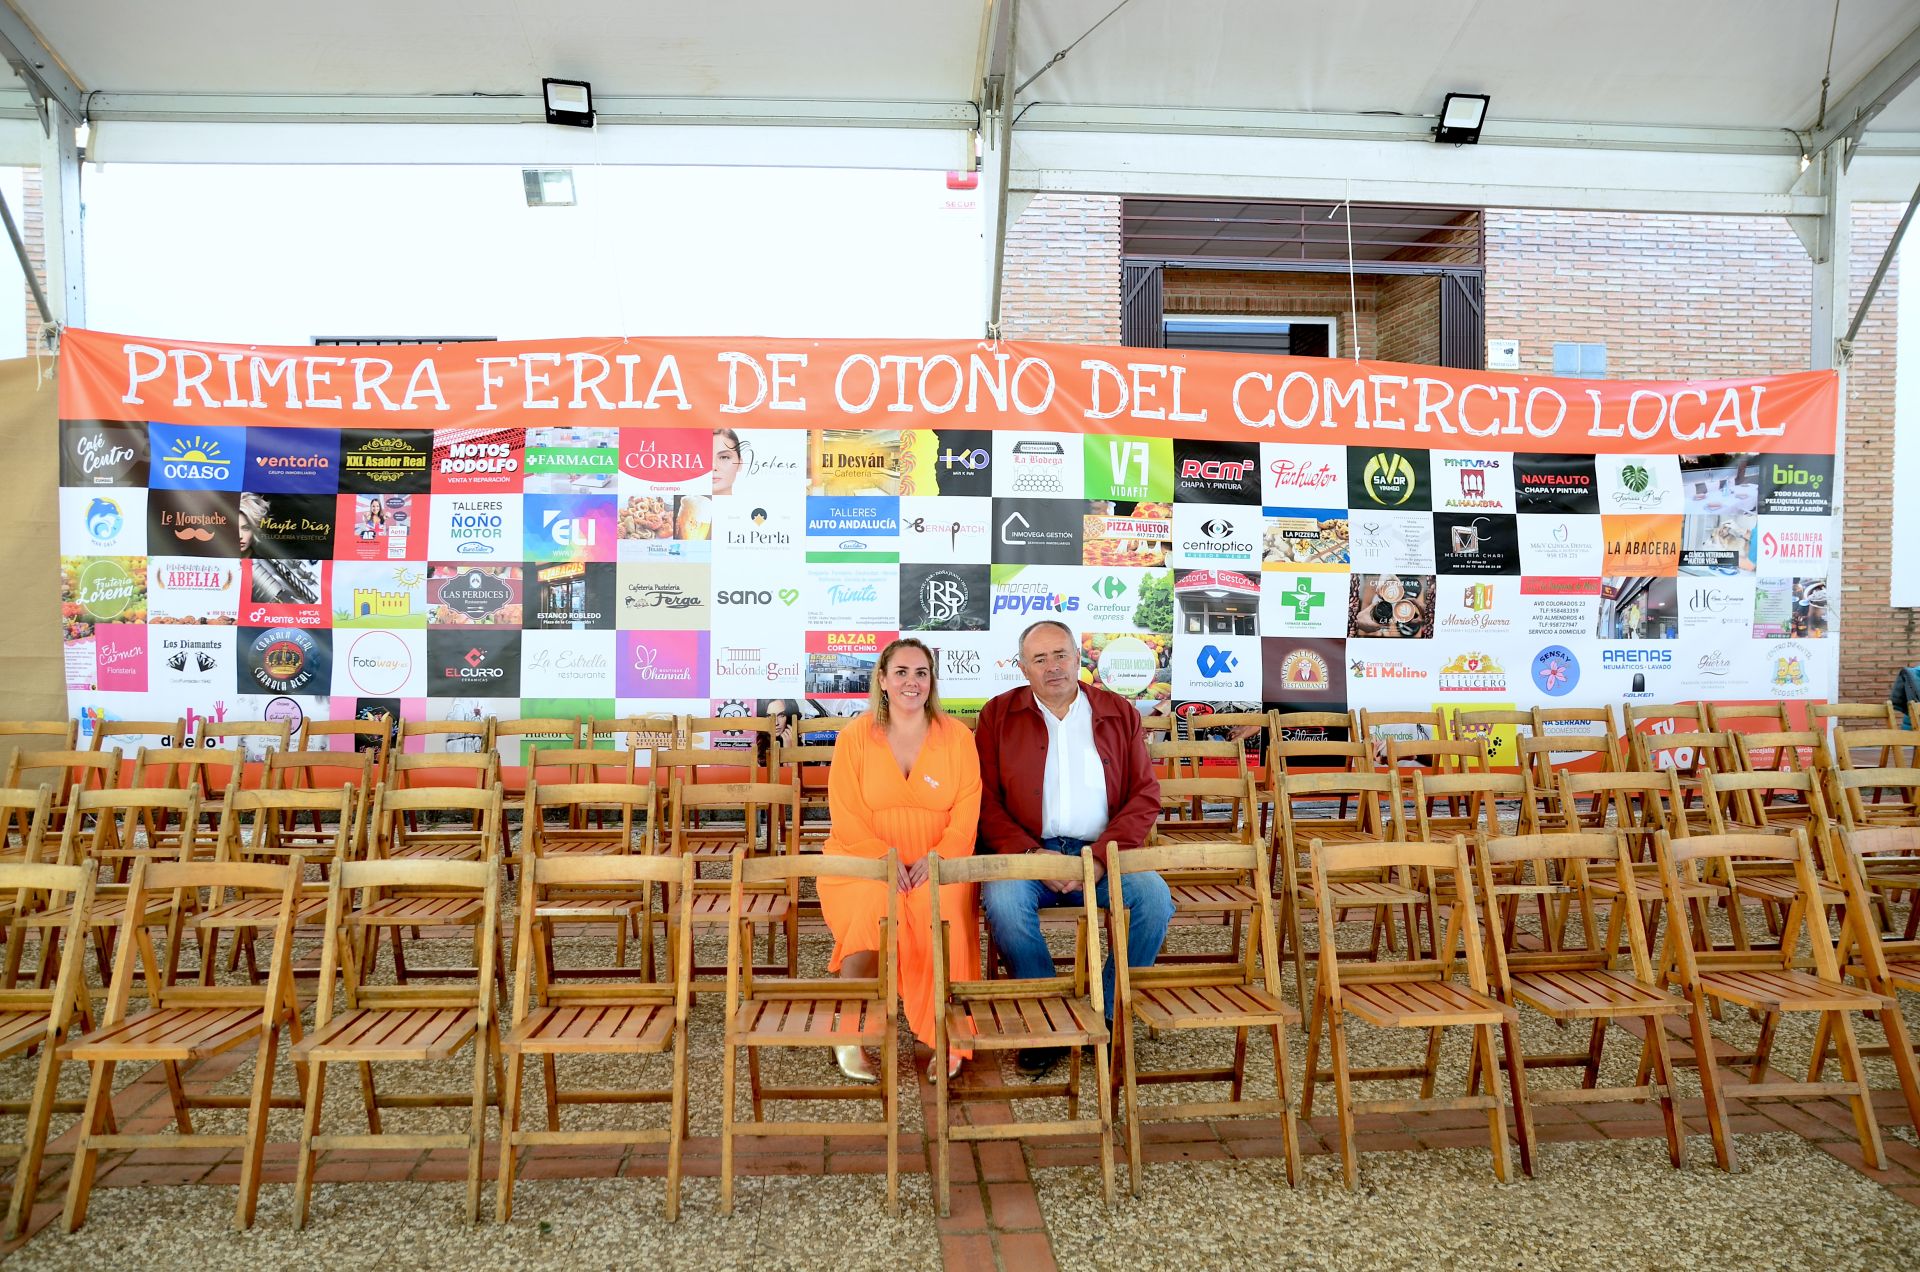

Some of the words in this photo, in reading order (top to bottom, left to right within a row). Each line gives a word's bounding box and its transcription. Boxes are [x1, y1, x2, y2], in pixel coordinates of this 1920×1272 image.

[121, 343, 451, 411] PRIMERA
[475, 352, 692, 412] FERIA
[718, 351, 807, 413] DE
[835, 341, 1055, 415] OTOÑO
[1081, 359, 1207, 423] DEL
[1232, 370, 1567, 438] COMERCIO
[1585, 385, 1786, 442] LOCAL
[77, 433, 105, 455] Café
[449, 442, 511, 459] MOTOS
[640, 440, 656, 453] LA
[83, 446, 135, 474] Centro
[256, 454, 329, 468] ventaria
[346, 455, 364, 468] XXL
[365, 455, 401, 468] Asador
[402, 454, 427, 468] Real
[440, 457, 519, 475] RODOLFO
[536, 453, 616, 467] FARMACIA
[625, 452, 706, 470] CORRIA
[822, 453, 834, 468] El
[837, 451, 885, 469] Desván
[1013, 454, 1027, 465] La
[1029, 454, 1063, 466] Bodega
[1443, 457, 1500, 469] PINTURAS
[163, 463, 230, 481] OCASO
[1772, 463, 1809, 486] bio
[1181, 480, 1205, 490] CHAPA
[1206, 481, 1213, 490] Y
[1213, 481, 1243, 491] PINTURA
[1522, 473, 1590, 486] NAVEAUTO
[1110, 485, 1149, 498] VIDAFIT
[1524, 486, 1548, 494] CHAPA
[1555, 487, 1589, 495] PINTURA
[1773, 490, 1791, 498] TODO
[452, 501, 503, 512] TALLERES
[1444, 498, 1503, 508] ALHAMBRA
[1802, 498, 1828, 506] CANINA
[829, 507, 878, 517] TALLERES
[1770, 505, 1794, 513] HUERTO
[161, 510, 173, 526] Le
[174, 510, 227, 526] Moustache
[451, 512, 502, 528] ÑOÑO
[808, 519, 839, 530] AUTO
[842, 517, 898, 530] ANDALUCÍA
[259, 519, 296, 532] Mayte
[300, 517, 331, 535] Díaz
[551, 518, 597, 546] ELI
[1106, 521, 1134, 532] PIZZA
[1135, 523, 1170, 534] HUETOR
[450, 528, 503, 539] MOTOR
[728, 531, 745, 544] La
[750, 531, 790, 544] Perla
[1046, 530, 1073, 539] GESTIÓN
[1780, 532, 1823, 542] GASOLINERA
[1182, 539, 1253, 553] centroptico
[1607, 541, 1622, 556] LA
[1624, 541, 1676, 556] ABACERA
[1780, 541, 1823, 558] MARTÍN
[168, 571, 220, 588] ABELIA
[76, 584, 135, 606] Lorena
[443, 590, 461, 599] LAS
[462, 590, 505, 600] PERDICES
[649, 591, 705, 609] Ferga
[717, 589, 773, 605] sano
[1087, 603, 1131, 612] Carrefour
[1093, 611, 1125, 621] express
[162, 639, 179, 649] Los
[180, 640, 222, 649] Diamantes
[827, 633, 876, 645] BAZAR
[102, 641, 117, 657] El
[827, 644, 852, 652] CORTE
[853, 644, 878, 652] CHINO
[947, 649, 980, 660] RUTA
[1539, 650, 1572, 664] SENSAY
[1602, 649, 1672, 662] ARENAS
[947, 663, 981, 674] VINO
[1365, 667, 1378, 678] El
[1381, 666, 1428, 678] Molino
[253, 666, 288, 691] CORRALA
[289, 670, 313, 689] REAL
[557, 671, 607, 680] restaurante
[1189, 680, 1233, 688] inmobiliaria
[1233, 680, 1245, 688] 3.0
[1456, 680, 1507, 688] LUCERO
